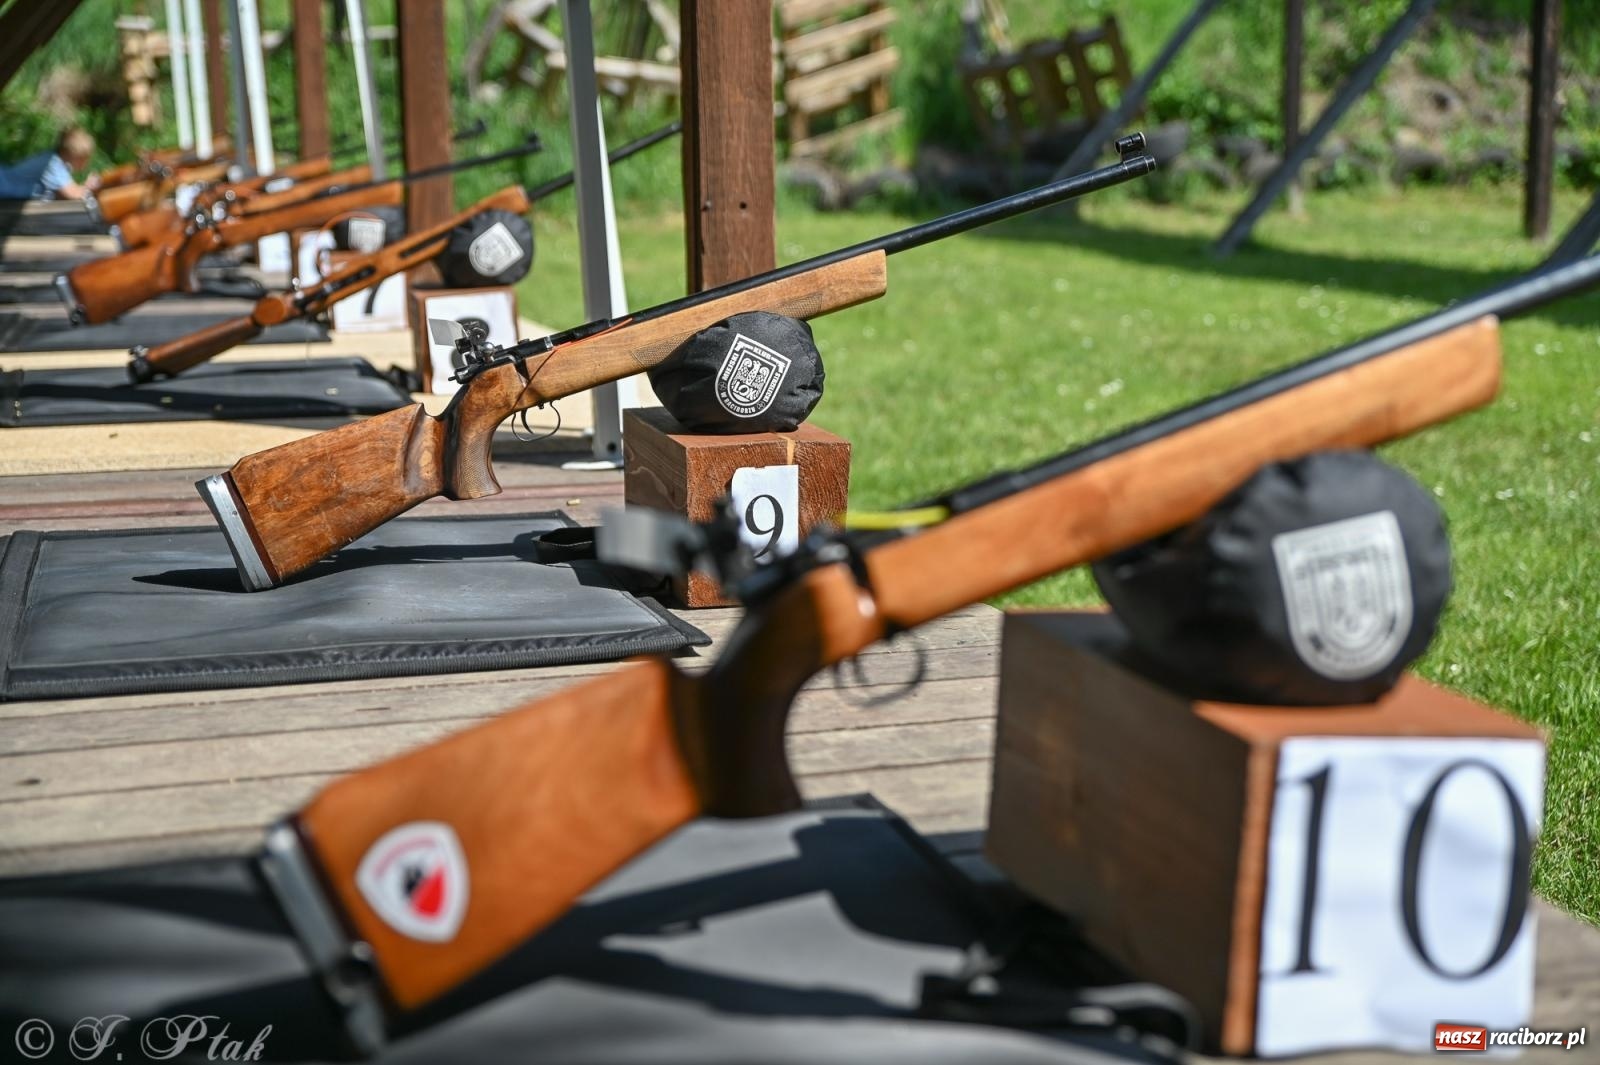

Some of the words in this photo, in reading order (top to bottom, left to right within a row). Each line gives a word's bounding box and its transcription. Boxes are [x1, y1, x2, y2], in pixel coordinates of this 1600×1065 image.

[722, 353, 740, 381] MIEJSKI
[753, 346, 772, 360] KLUB
[745, 494, 784, 559] 9
[1260, 757, 1532, 981] 10
